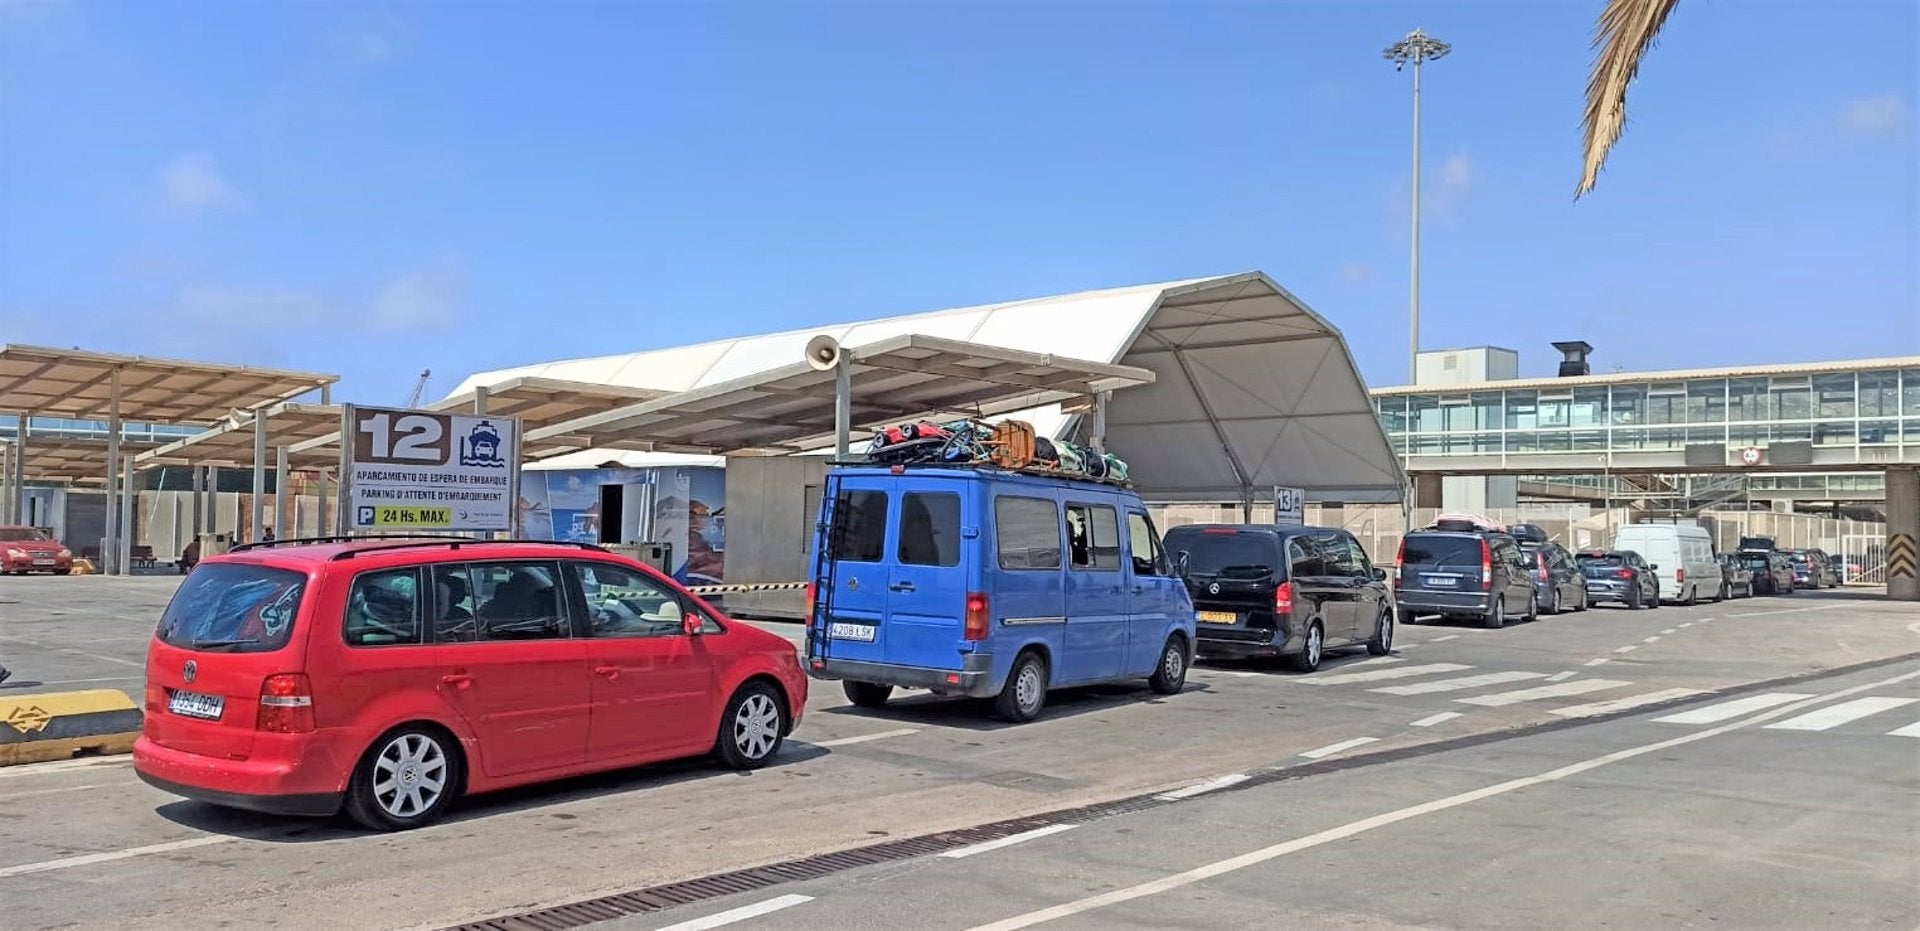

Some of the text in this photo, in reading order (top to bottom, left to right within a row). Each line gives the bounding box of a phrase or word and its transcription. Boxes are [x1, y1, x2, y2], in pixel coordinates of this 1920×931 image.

[360, 413, 443, 460] 12
[356, 471, 507, 486] APARCAMIENTO DE ESPERA DE EMBARQUE
[361, 489, 502, 501] PARKING D'ATTENTE D'EMBARQUEMENT
[1279, 489, 1291, 510] 13
[360, 507, 449, 523] P 24 Hs. MAX.
